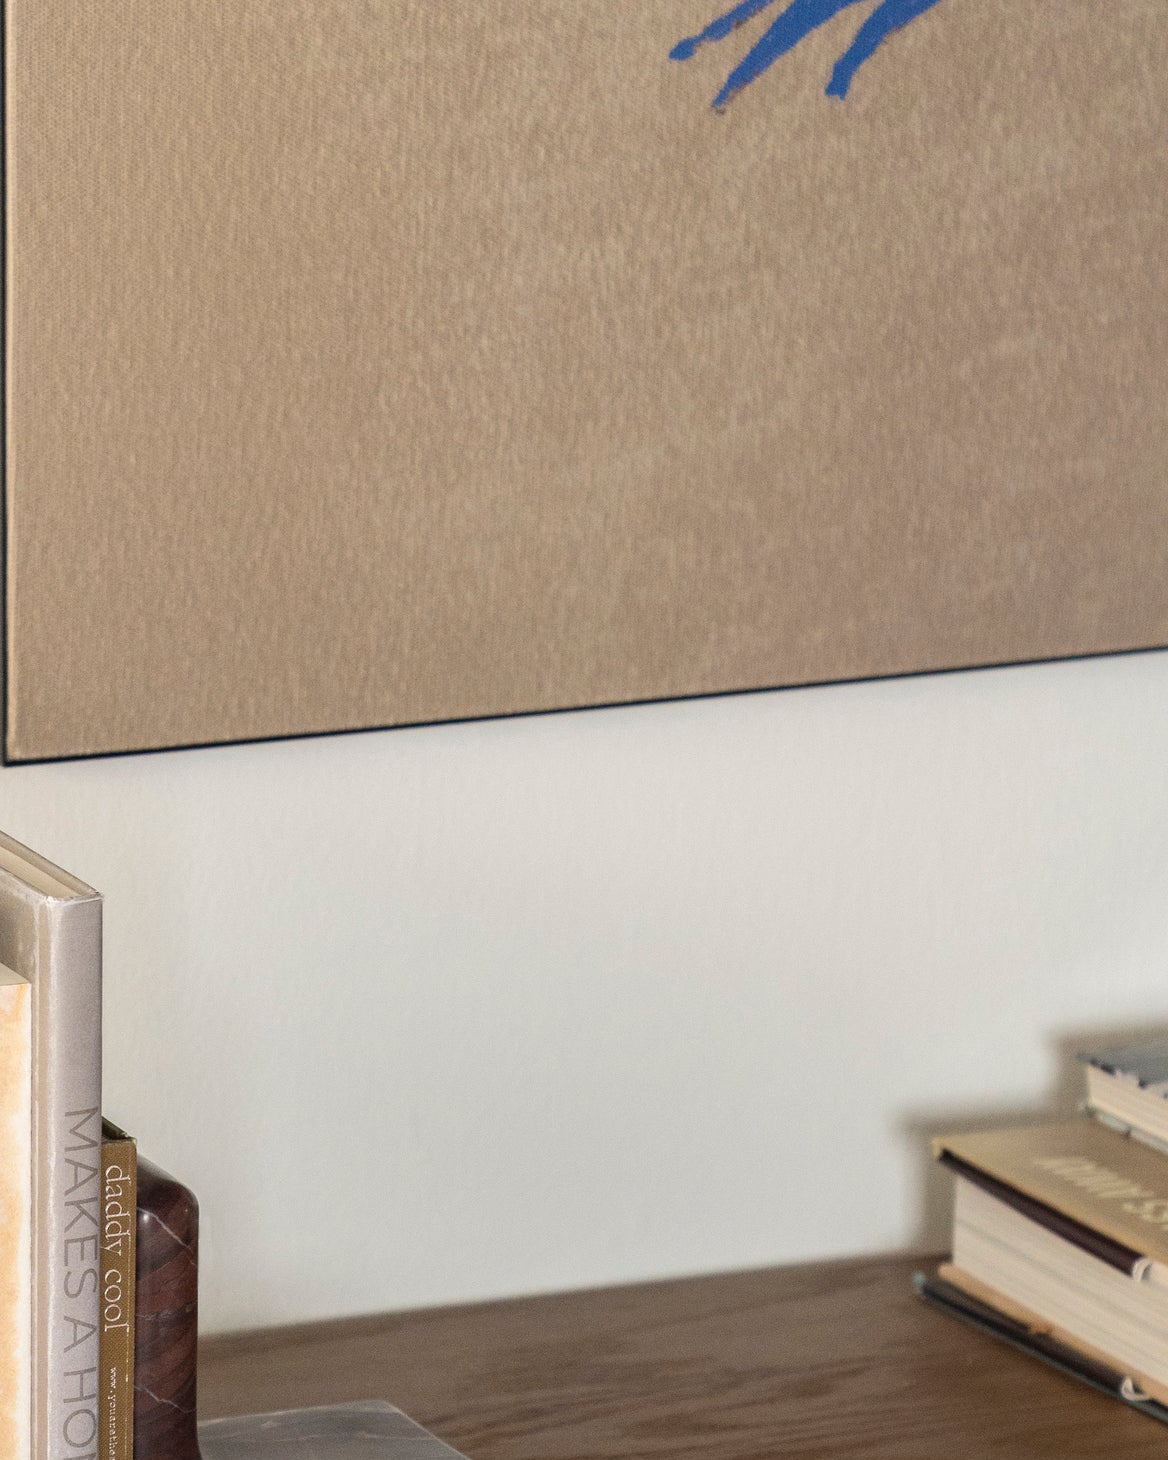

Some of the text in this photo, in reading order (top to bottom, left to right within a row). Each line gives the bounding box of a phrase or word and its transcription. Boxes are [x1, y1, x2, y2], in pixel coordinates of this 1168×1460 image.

[63, 1107, 99, 1300] MAKES
[101, 1165, 130, 1333] daddy cool
[62, 1314, 96, 1362] A
